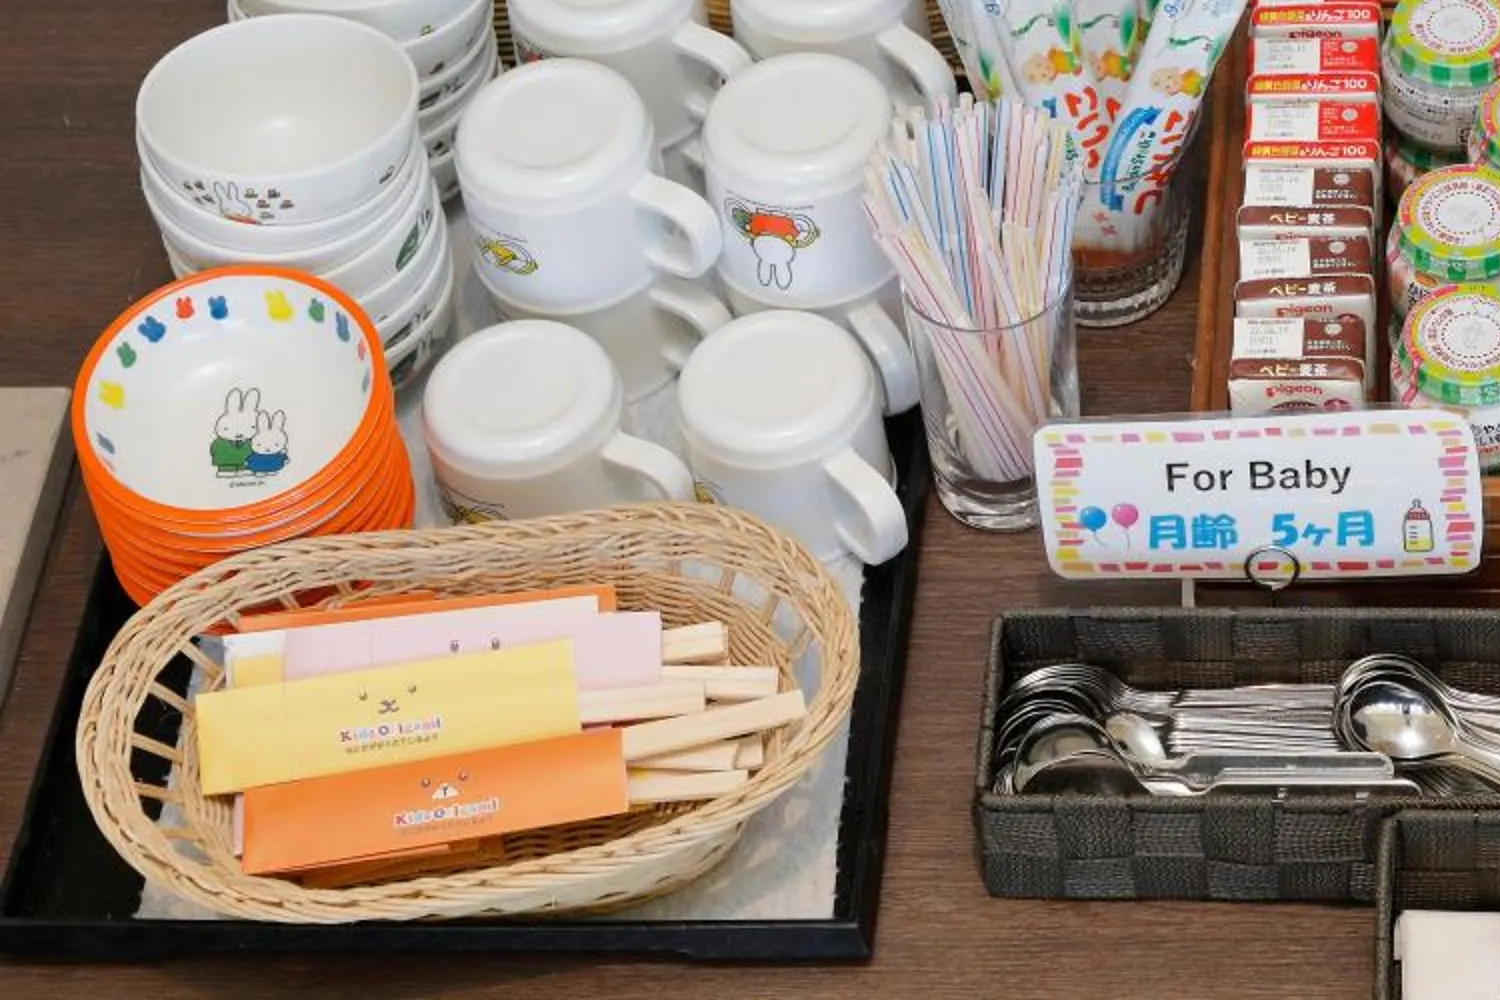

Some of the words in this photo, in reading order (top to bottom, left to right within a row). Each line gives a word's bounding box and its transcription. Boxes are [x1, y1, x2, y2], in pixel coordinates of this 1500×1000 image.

[1165, 463, 1233, 493] For
[1249, 459, 1352, 494] Baby
[1149, 512, 1238, 550] 月齢
